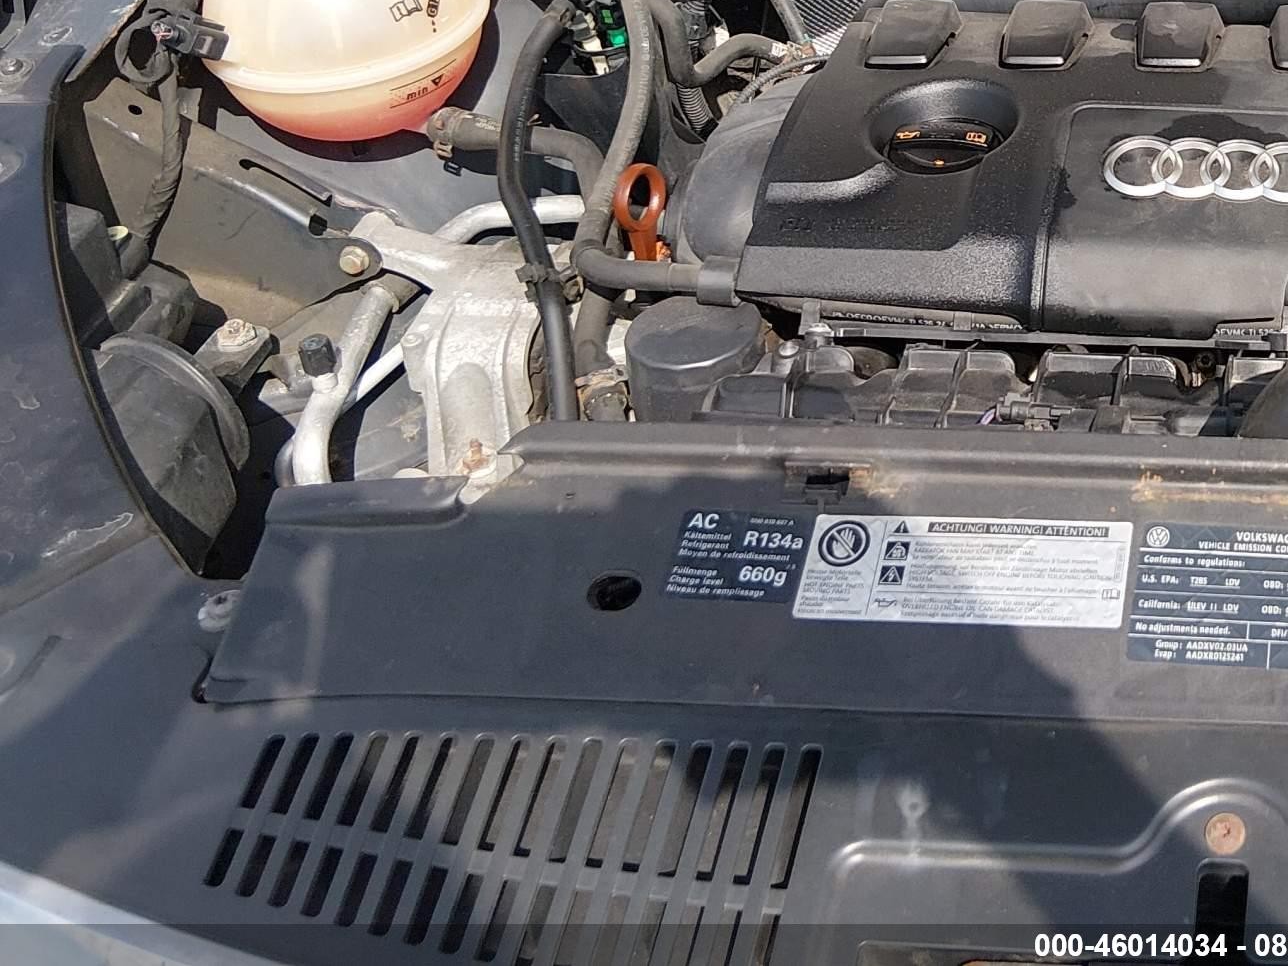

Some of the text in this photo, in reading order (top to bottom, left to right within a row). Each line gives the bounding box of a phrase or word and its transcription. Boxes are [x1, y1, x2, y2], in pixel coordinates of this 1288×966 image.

[406, 86, 429, 101] min
[688, 512, 720, 529] AC
[932, 522, 987, 533] ACHTUNG!
[990, 523, 1044, 535] WARNING!
[681, 540, 730, 550] Refrigerant
[743, 530, 804, 549] R134a
[1198, 541, 1231, 551] VEHICLE
[1233, 543, 1272, 553] EMISSION
[678, 548, 791, 561] Moyen de refroidissement
[1143, 554, 1246, 568] Conforms to regulations:
[669, 574, 724, 585] Charge level
[738, 565, 788, 587] 660g
[1142, 575, 1158, 583] U.S.
[1161, 575, 1179, 584] EPA:
[1225, 578, 1241, 586] LDV
[1263, 580, 1284, 589] OBD:
[666, 584, 765, 597] Niveau de remplissage
[1138, 599, 1181, 610] California:
[1223, 603, 1239, 612] LDV
[1261, 605, 1282, 614] OBD:
[1135, 622, 1231, 635] No adjustments needed.
